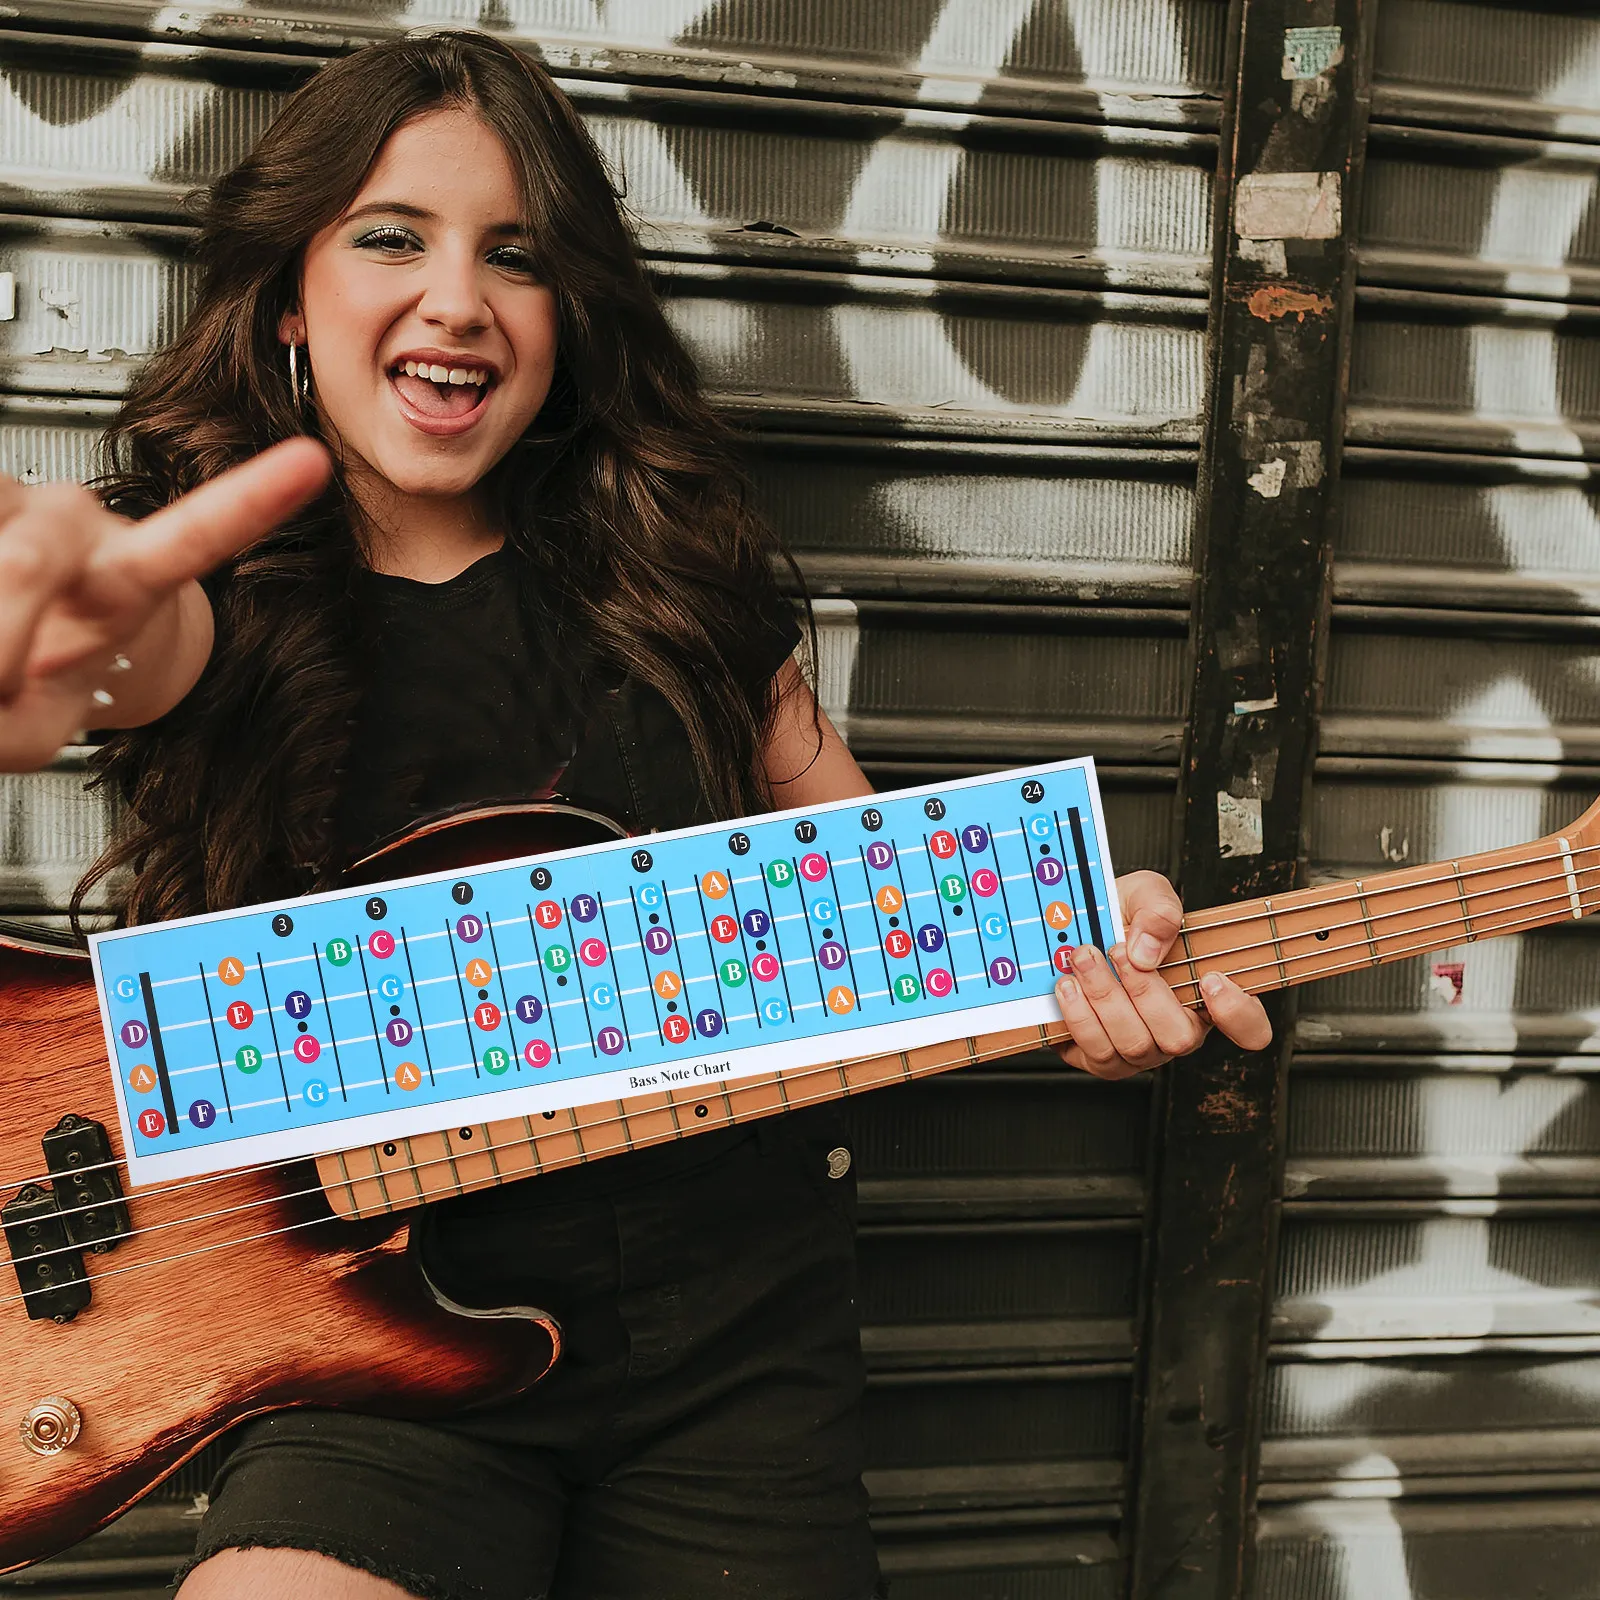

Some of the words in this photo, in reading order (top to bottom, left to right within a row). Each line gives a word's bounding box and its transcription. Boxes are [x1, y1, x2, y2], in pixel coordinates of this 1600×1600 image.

[118, 980, 133, 996] G
[225, 961, 240, 978] A
[332, 942, 347, 960] B
[373, 935, 388, 953] C
[462, 920, 478, 937] D
[540, 905, 556, 923] E
[578, 898, 590, 917] F
[641, 887, 657, 904] G
[709, 875, 724, 892] A
[773, 864, 789, 881] B
[805, 858, 820, 876] C
[872, 847, 889, 864] D
[935, 835, 951, 853] E
[968, 829, 981, 847] F
[1032, 818, 1048, 835] G
[279, 918, 287, 931] 3
[372, 901, 380, 914] 5
[458, 886, 465, 899] 7
[537, 872, 545, 885] 9
[633, 853, 649, 867] 12
[731, 836, 747, 850] 15
[797, 824, 811, 838] 17
[864, 812, 879, 826] 19
[927, 801, 942, 815] 21
[1024, 784, 1042, 798] 24
[128, 1025, 143, 1043] D
[231, 1006, 247, 1024] E
[291, 995, 305, 1013] F
[382, 980, 398, 996] G
[472, 963, 487, 980] A
[550, 949, 566, 966] B
[585, 943, 600, 961] C
[651, 932, 668, 949] D
[716, 920, 732, 937] E
[750, 913, 763, 931] F
[814, 902, 831, 919] G
[883, 889, 898, 907] A
[945, 879, 961, 896] B
[976, 873, 991, 891] C
[1042, 862, 1059, 880] D
[137, 1068, 151, 1086] A
[242, 1050, 257, 1067] B
[298, 1039, 313, 1057] C
[393, 1023, 408, 1041] D
[479, 1007, 495, 1025] E
[523, 1000, 535, 1018] F
[594, 987, 610, 1004] G
[661, 974, 676, 992] A
[726, 963, 742, 981] B
[757, 958, 772, 976] C
[824, 946, 841, 964] D
[890, 934, 906, 952] E
[924, 928, 937, 947] F
[986, 918, 1001, 935] G
[1052, 905, 1067, 922] A
[144, 1114, 159, 1132] E
[195, 1104, 209, 1122] F
[308, 1084, 323, 1101] G
[402, 1066, 417, 1083] A
[489, 1051, 505, 1068] B
[529, 1044, 544, 1062] C
[603, 1032, 620, 1049] D
[669, 1020, 684, 1038] E
[703, 1013, 716, 1031] F
[766, 1002, 782, 1020] G
[834, 990, 849, 1007] A
[900, 978, 915, 996] B
[930, 973, 946, 991] C
[996, 962, 1012, 980] D
[629, 1075, 658, 1089] Bass
[660, 1070, 690, 1083] Note
[693, 1061, 731, 1077] Chart
